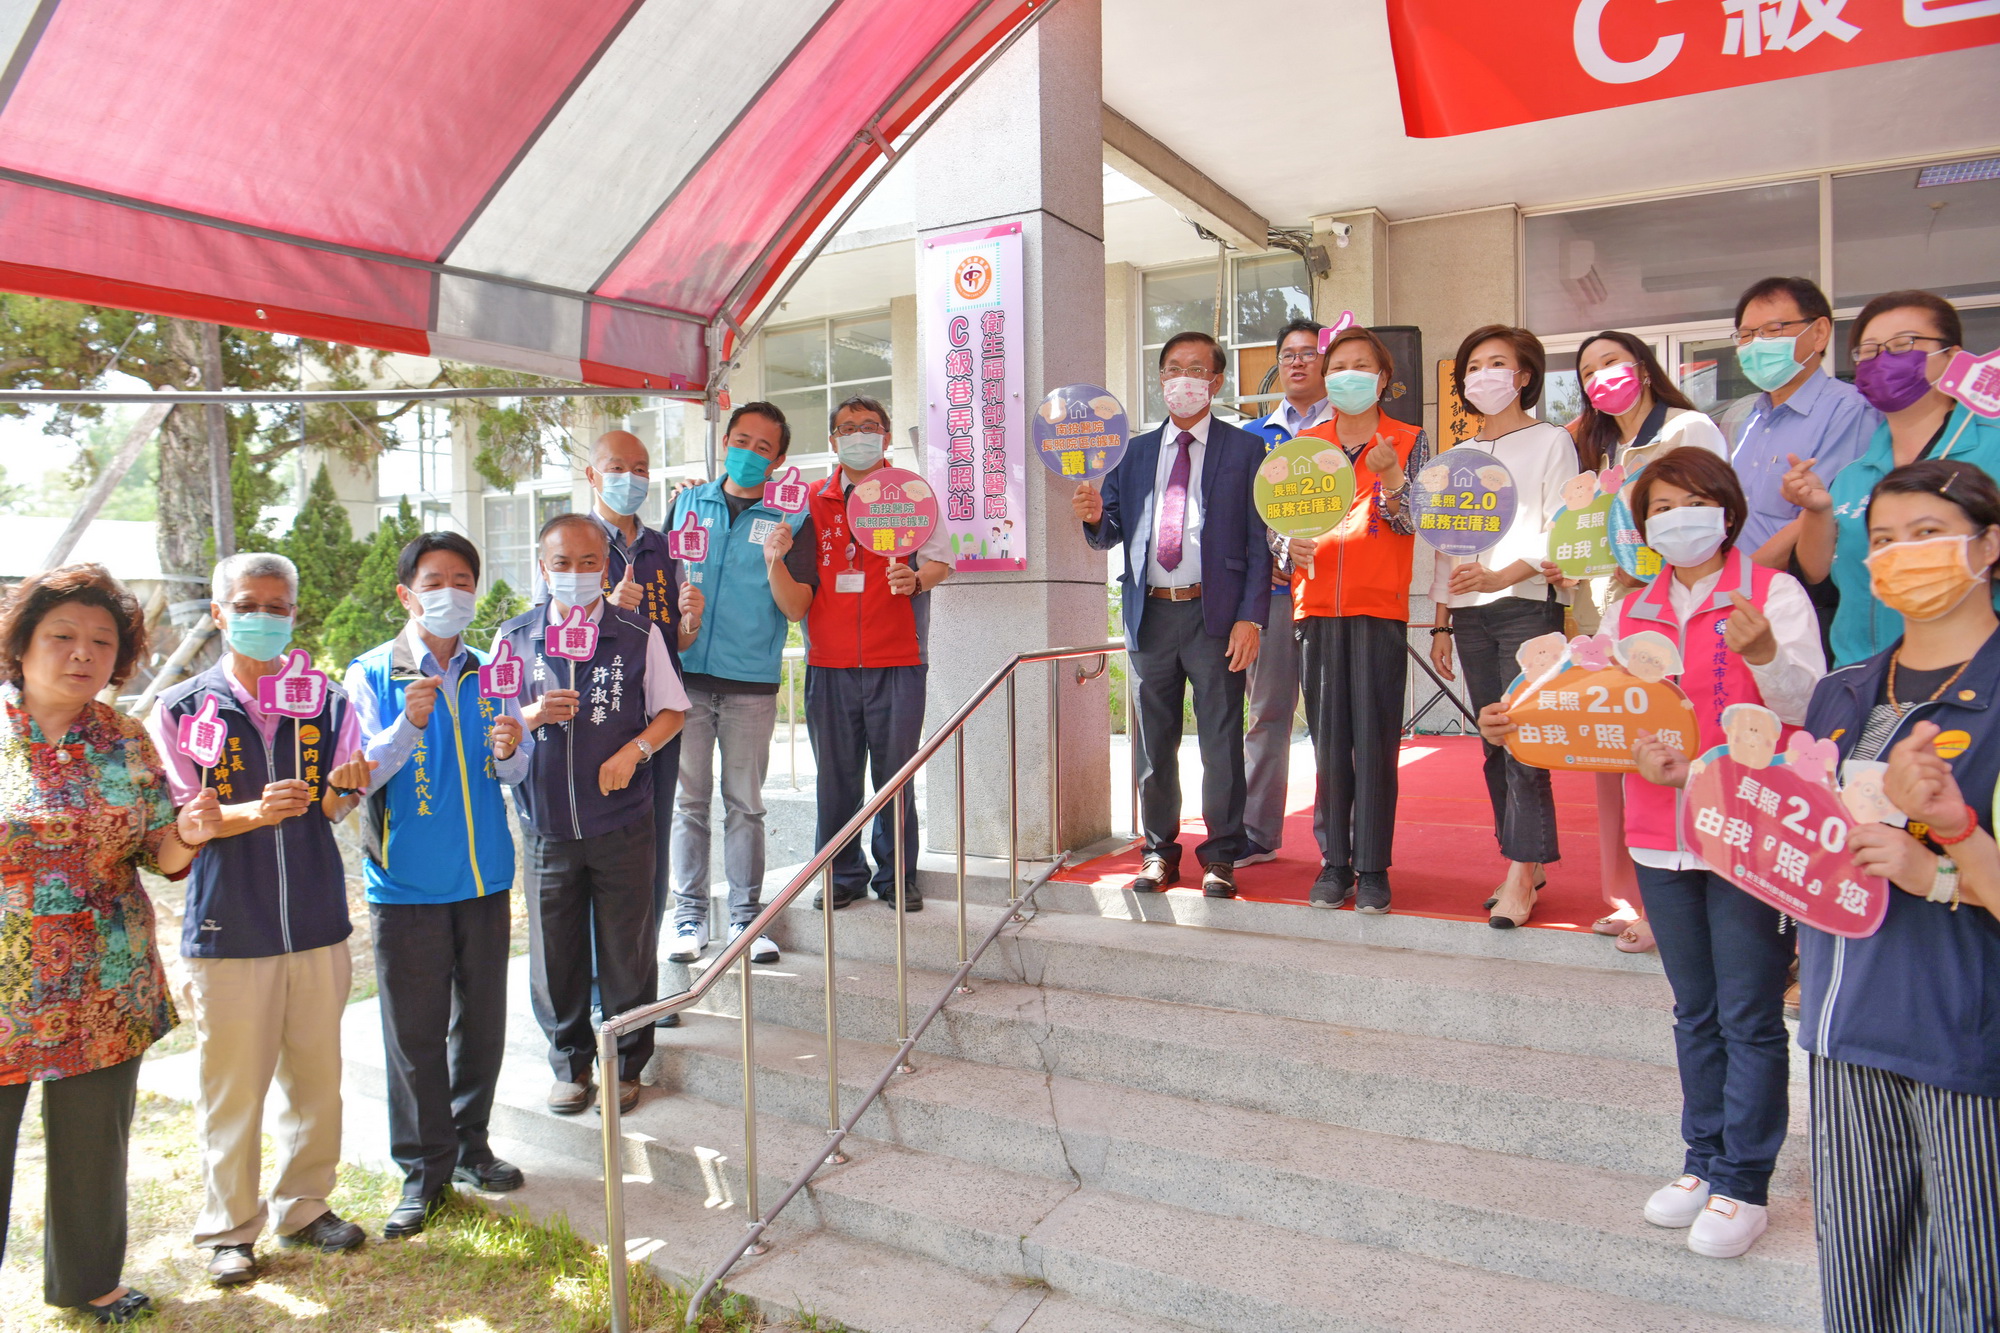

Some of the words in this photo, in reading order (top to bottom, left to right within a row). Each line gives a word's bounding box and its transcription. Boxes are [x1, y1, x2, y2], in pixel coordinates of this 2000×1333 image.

[946, 315, 975, 520] C級巷弄長照站
[981, 310, 1007, 520] 衛生福利部南投醫院
[1055, 420, 1105, 436] 南投醫院
[1060, 450, 1086, 475] 讚
[781, 485, 800, 503] 讚
[1273, 482, 1298, 498] 長照
[1300, 474, 1336, 495] 2.0
[869, 502, 915, 514] 南投醫院
[1266, 496, 1343, 519] 服務在厝邊
[1430, 493, 1456, 508] 長照
[1459, 491, 1497, 511] 2.0
[834, 514, 843, 537] 院長
[1419, 513, 1501, 532] 服務在厝邊
[1576, 511, 1605, 530] 長照
[684, 532, 701, 550] 讚
[873, 528, 895, 551] 讚
[566, 628, 587, 648] 讚
[496, 663, 515, 686] 讚
[533, 653, 546, 680] 主任
[285, 677, 312, 702] 讚
[610, 655, 624, 712] 立法委員
[590, 667, 609, 725] 許淑華
[1537, 690, 1581, 711] 長照
[1586, 685, 1649, 714] 2.0
[196, 721, 215, 750] 讚
[228, 737, 245, 771] 里長
[1735, 776, 1782, 817] 長照
[1781, 795, 1848, 853] 2.0
